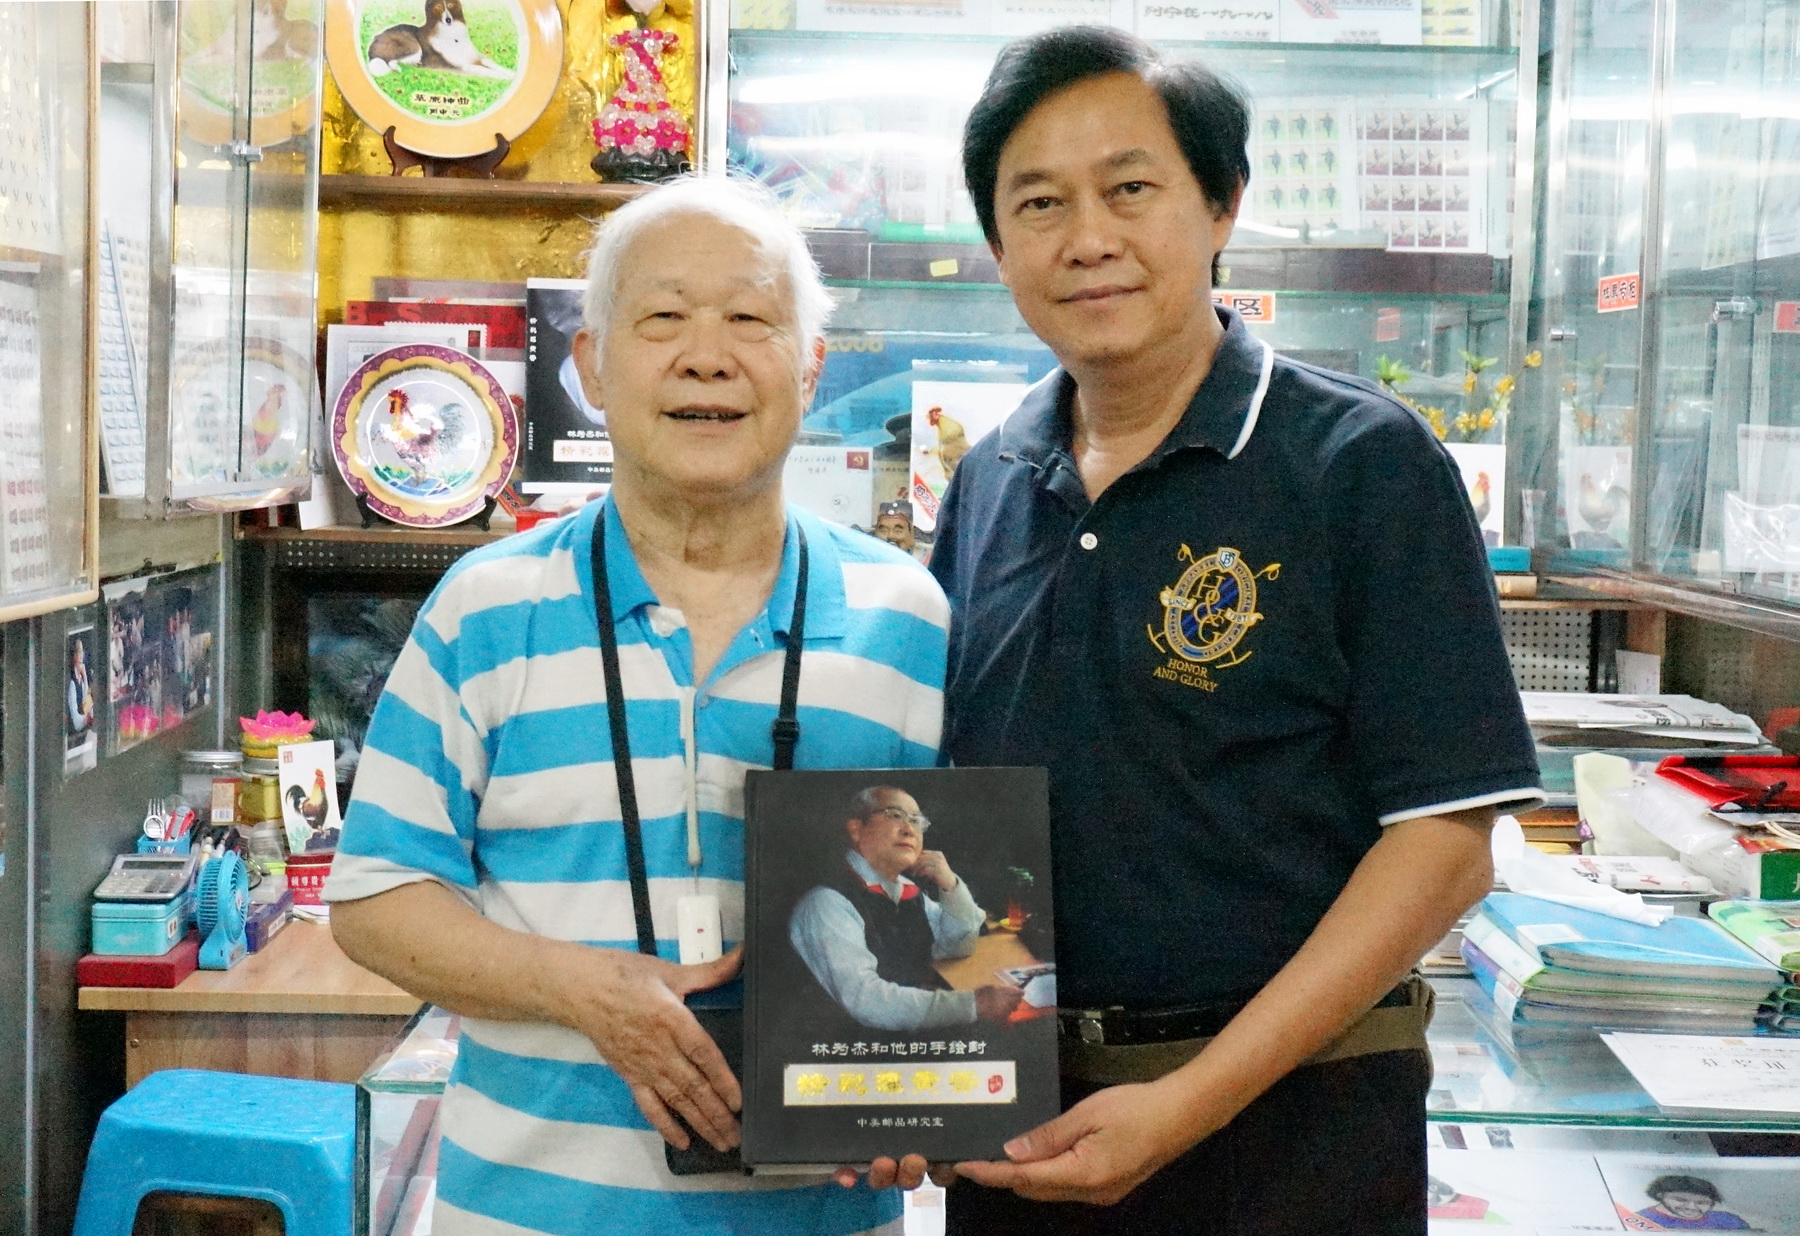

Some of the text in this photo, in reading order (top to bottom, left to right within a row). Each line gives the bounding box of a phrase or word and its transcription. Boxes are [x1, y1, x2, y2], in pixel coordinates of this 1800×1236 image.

[1167, 658, 1208, 678] HONOR
[1153, 666, 1218, 692] AND GLORY
[811, 1040, 987, 1056] 林为杰和他的手绘封
